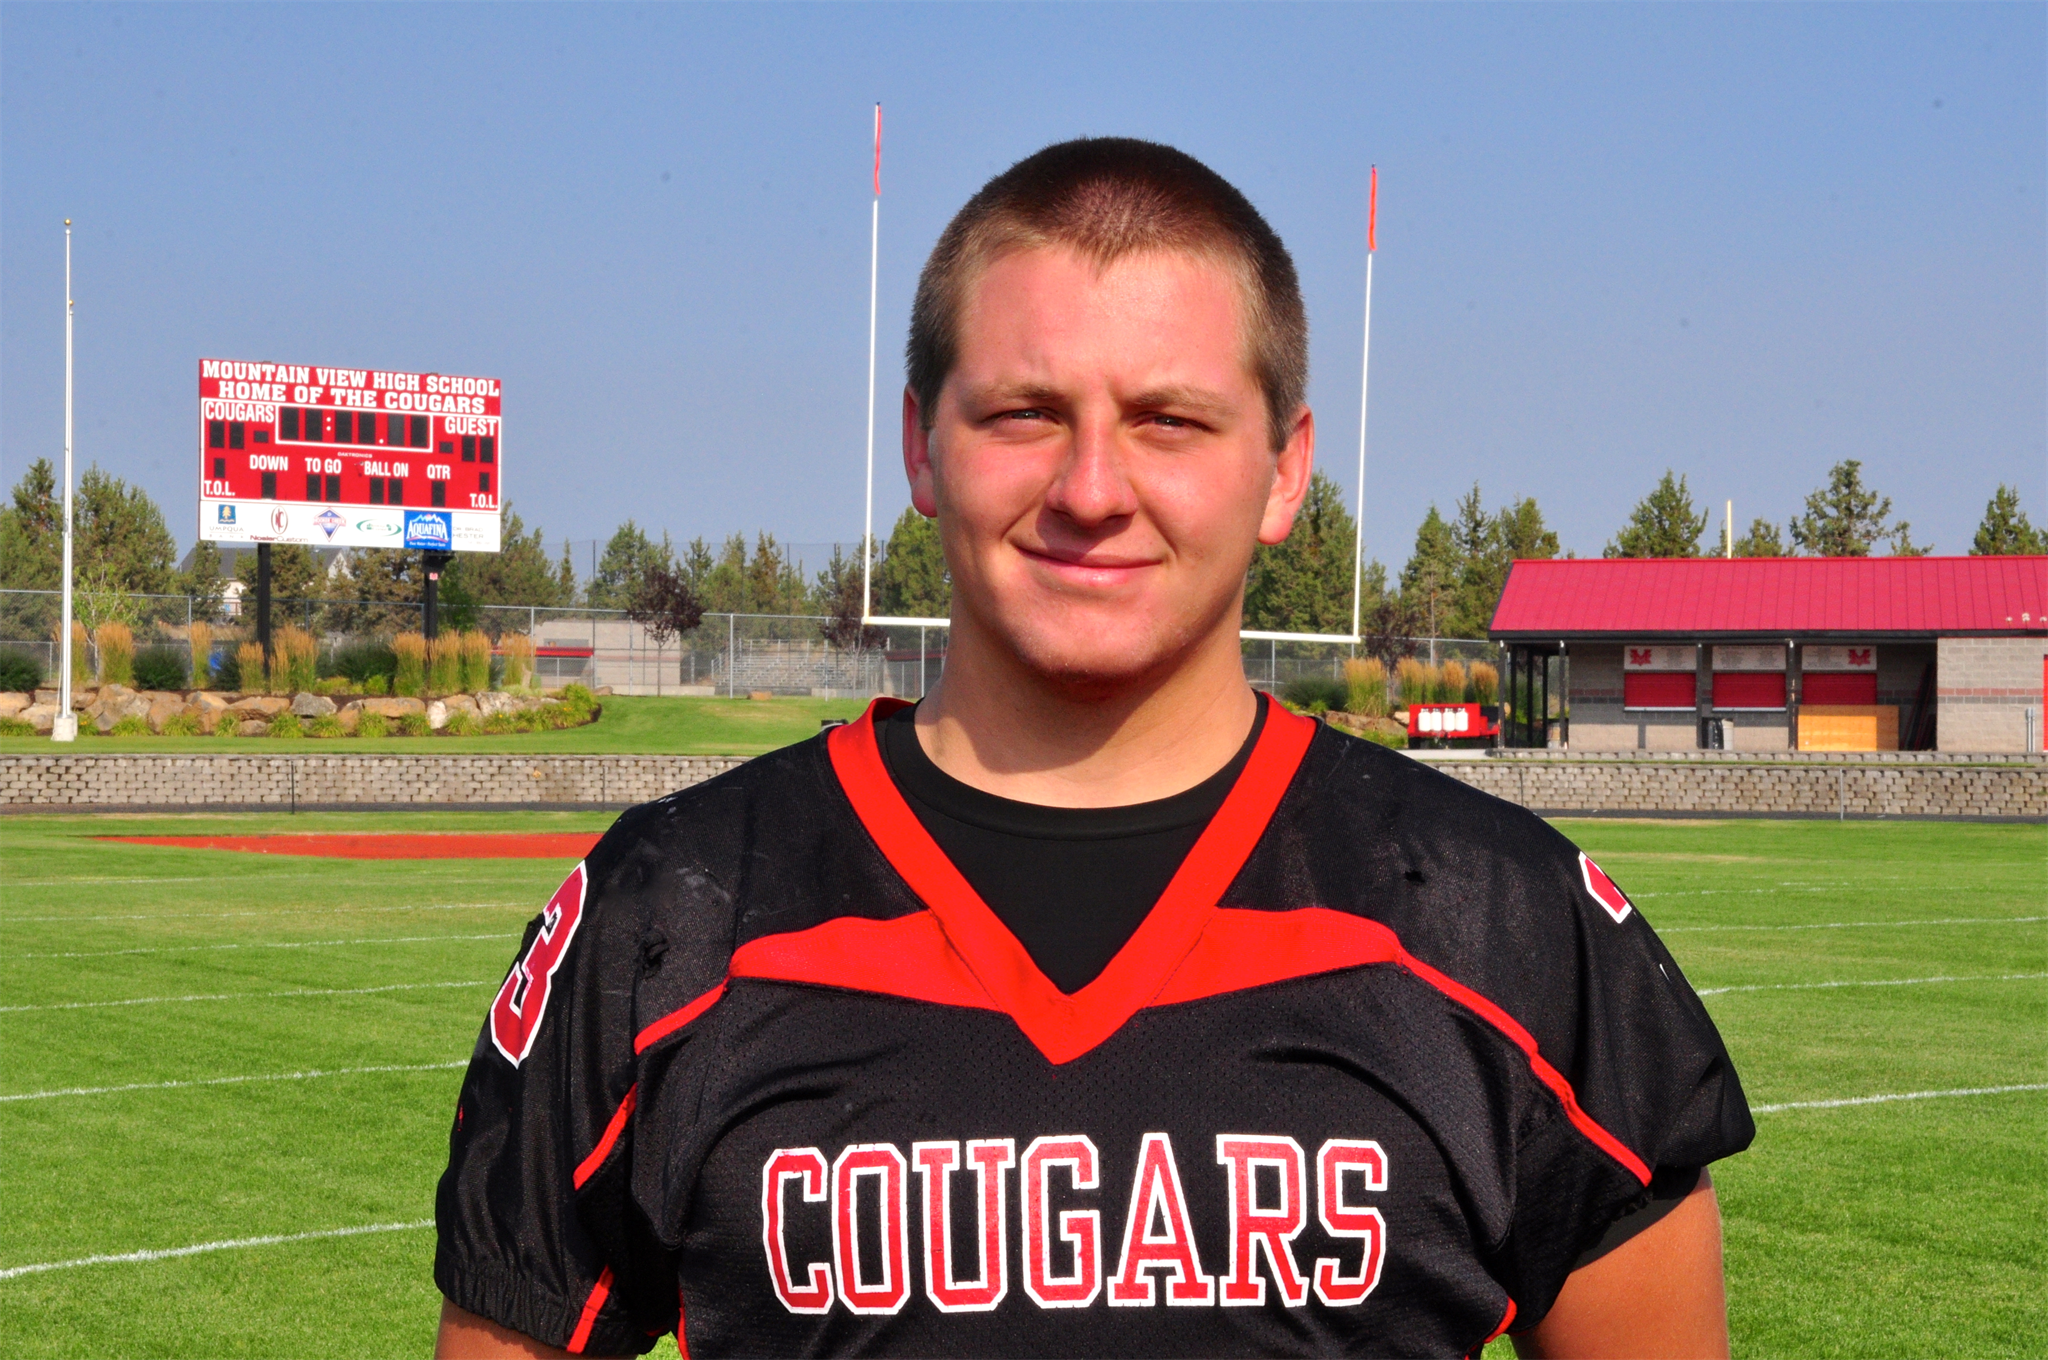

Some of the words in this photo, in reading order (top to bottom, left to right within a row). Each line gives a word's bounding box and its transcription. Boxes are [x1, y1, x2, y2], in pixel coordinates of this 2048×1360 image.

[203, 360, 309, 384] MOUNTAIN
[316, 367, 367, 388] VIEW
[373, 371, 420, 391] HIGH
[426, 375, 500, 397] SCHOOL
[218, 380, 286, 401] HOME
[294, 385, 323, 404] OF
[330, 388, 377, 407] THE
[384, 391, 485, 414] COUGARS
[205, 400, 275, 423] COUGARS
[444, 416, 497, 436] GUEST
[249, 454, 288, 471] DOWN
[304, 458, 321, 472] TO
[324, 458, 342, 474] GO
[364, 461, 391, 476] BALL
[393, 462, 409, 478] ON
[427, 464, 451, 479] QTR
[204, 480, 236, 496] T.O.L.
[469, 493, 498, 508] T.O.L.
[406, 520, 449, 542] AQUAFINA
[490, 859, 588, 1070] 3
[762, 1132, 1389, 1316] COUGARS
